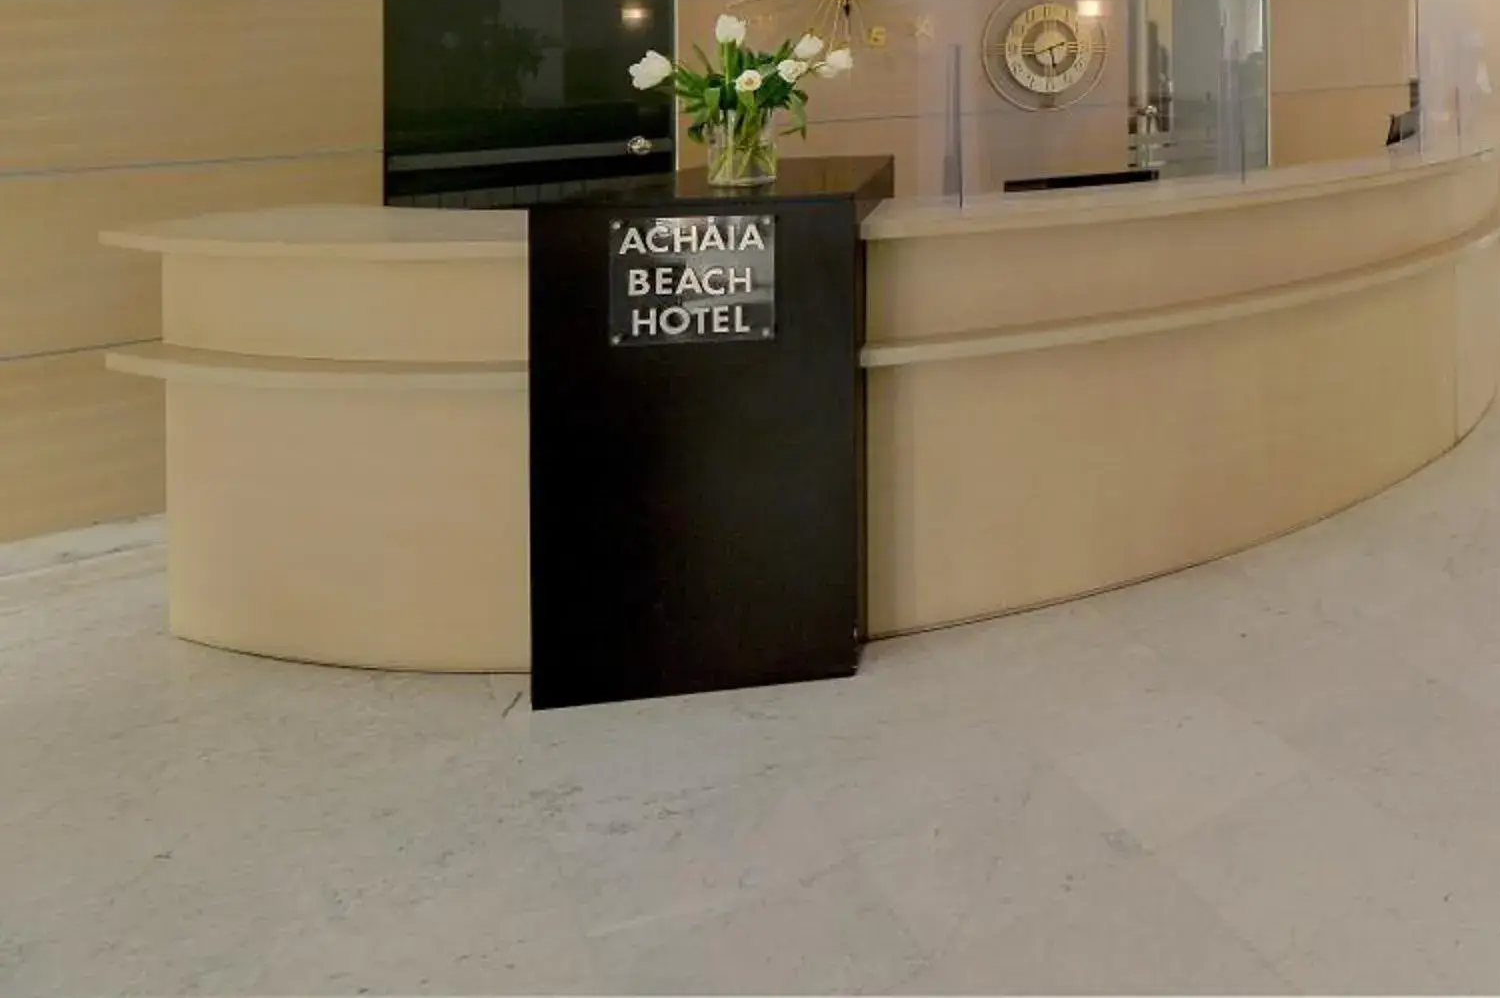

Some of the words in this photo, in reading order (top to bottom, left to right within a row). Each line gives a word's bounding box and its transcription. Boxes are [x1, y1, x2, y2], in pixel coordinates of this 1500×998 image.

[618, 223, 765, 255] ACHAIA
[627, 267, 752, 296] BEACH
[631, 305, 750, 336] HOTEL
